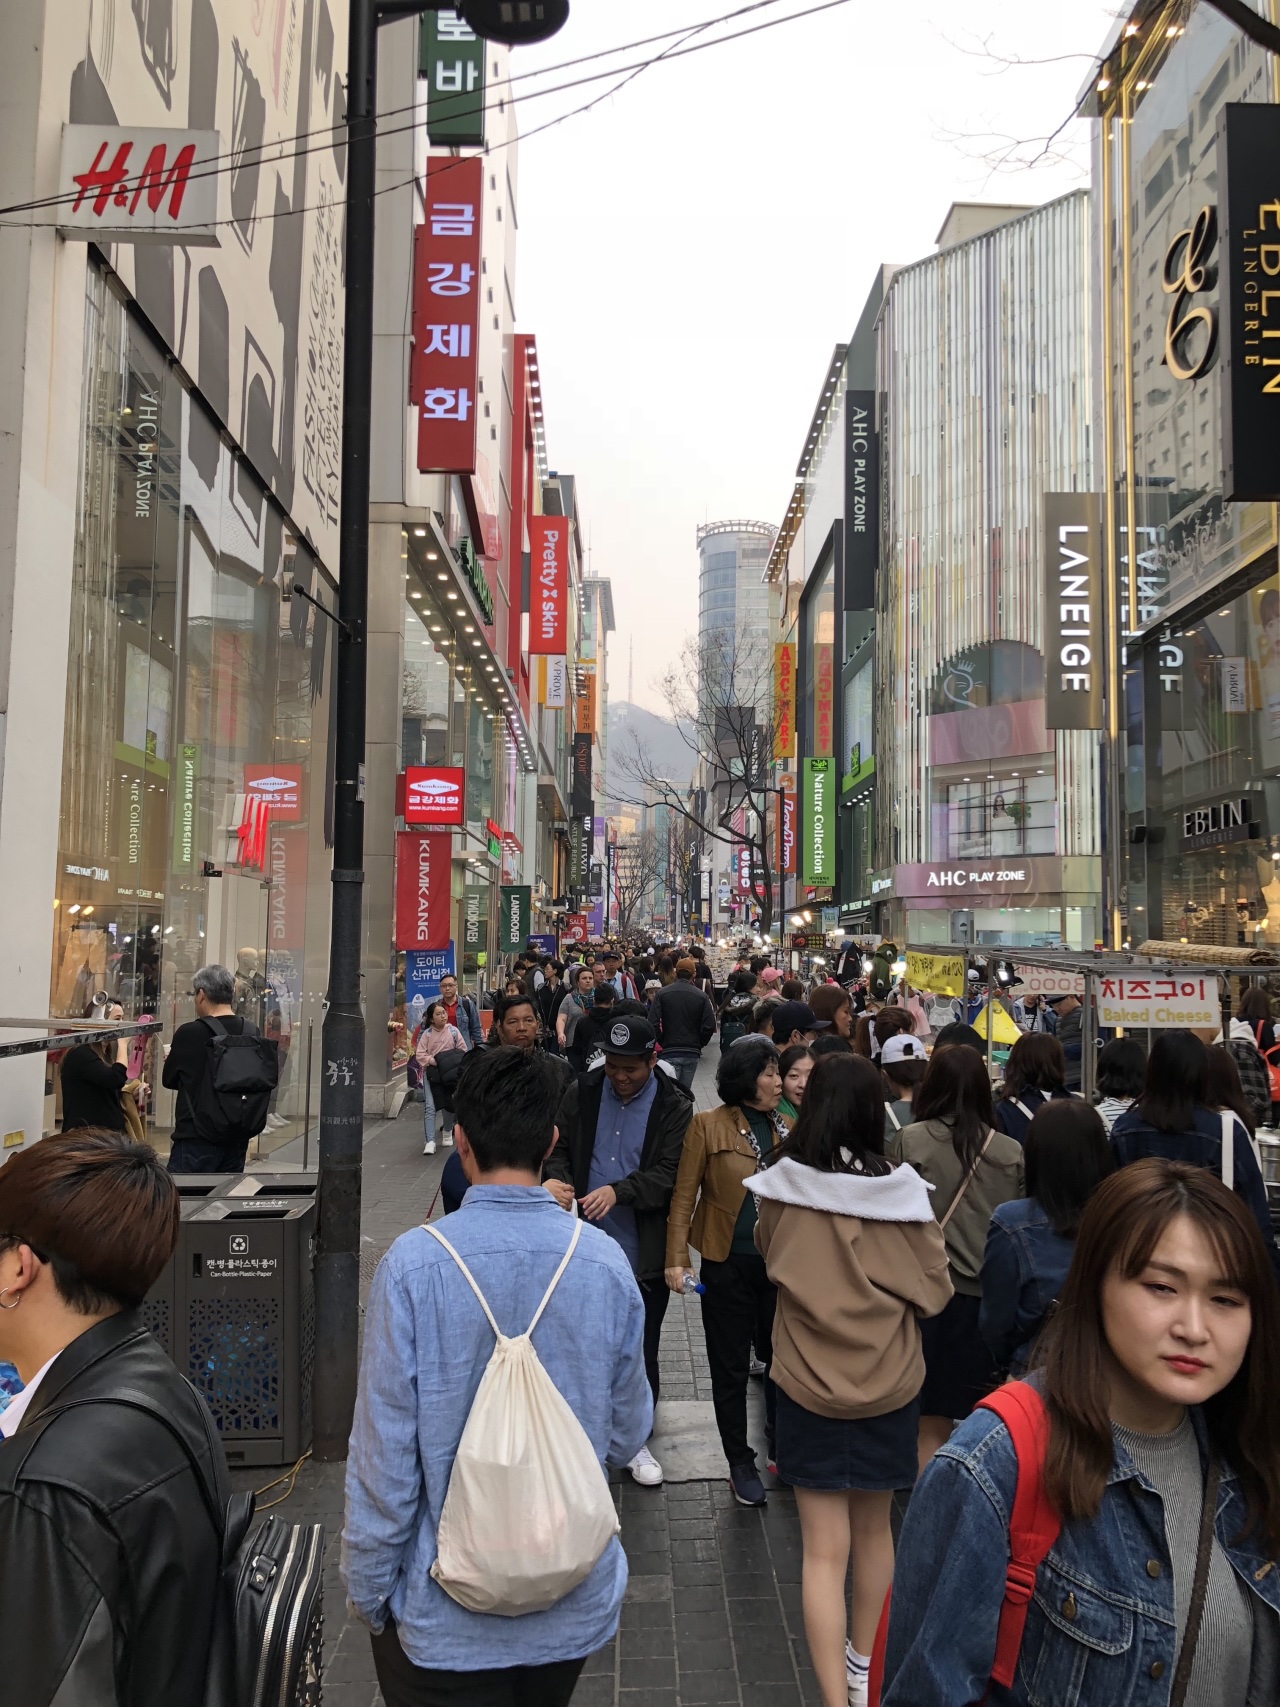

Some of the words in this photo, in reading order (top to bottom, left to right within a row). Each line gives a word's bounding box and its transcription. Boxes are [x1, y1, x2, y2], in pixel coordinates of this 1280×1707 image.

[72, 141, 196, 220] H&M
[423, 204, 475, 421] 금강제화
[1243, 229, 1259, 365] LINGERIE
[303, 314, 317, 496] FASHION
[852, 406, 868, 453] AHC
[315, 398, 326, 524] AFTER
[854, 459, 866, 493] PLAY
[853, 496, 866, 533] ZONE
[539, 530, 559, 588] Pretty
[541, 601, 558, 639] skin
[1059, 525, 1091, 693] LANEIGE
[814, 774, 824, 812] Nature
[129, 804, 141, 864] Collection
[1183, 799, 1243, 838] EBLIN
[814, 815, 825, 874] Collection
[417, 839, 430, 941] KUMKANG
[927, 871, 967, 887] AHC
[969, 872, 995, 882] PLAY
[996, 870, 1025, 881] ZONE
[510, 895, 520, 944] LANDROVER
[416, 956, 445, 967] 도이터
[1101, 978, 1205, 1000] 치즈구이
[1103, 1008, 1149, 1022] Baked
[1155, 1007, 1212, 1022] Cheese
